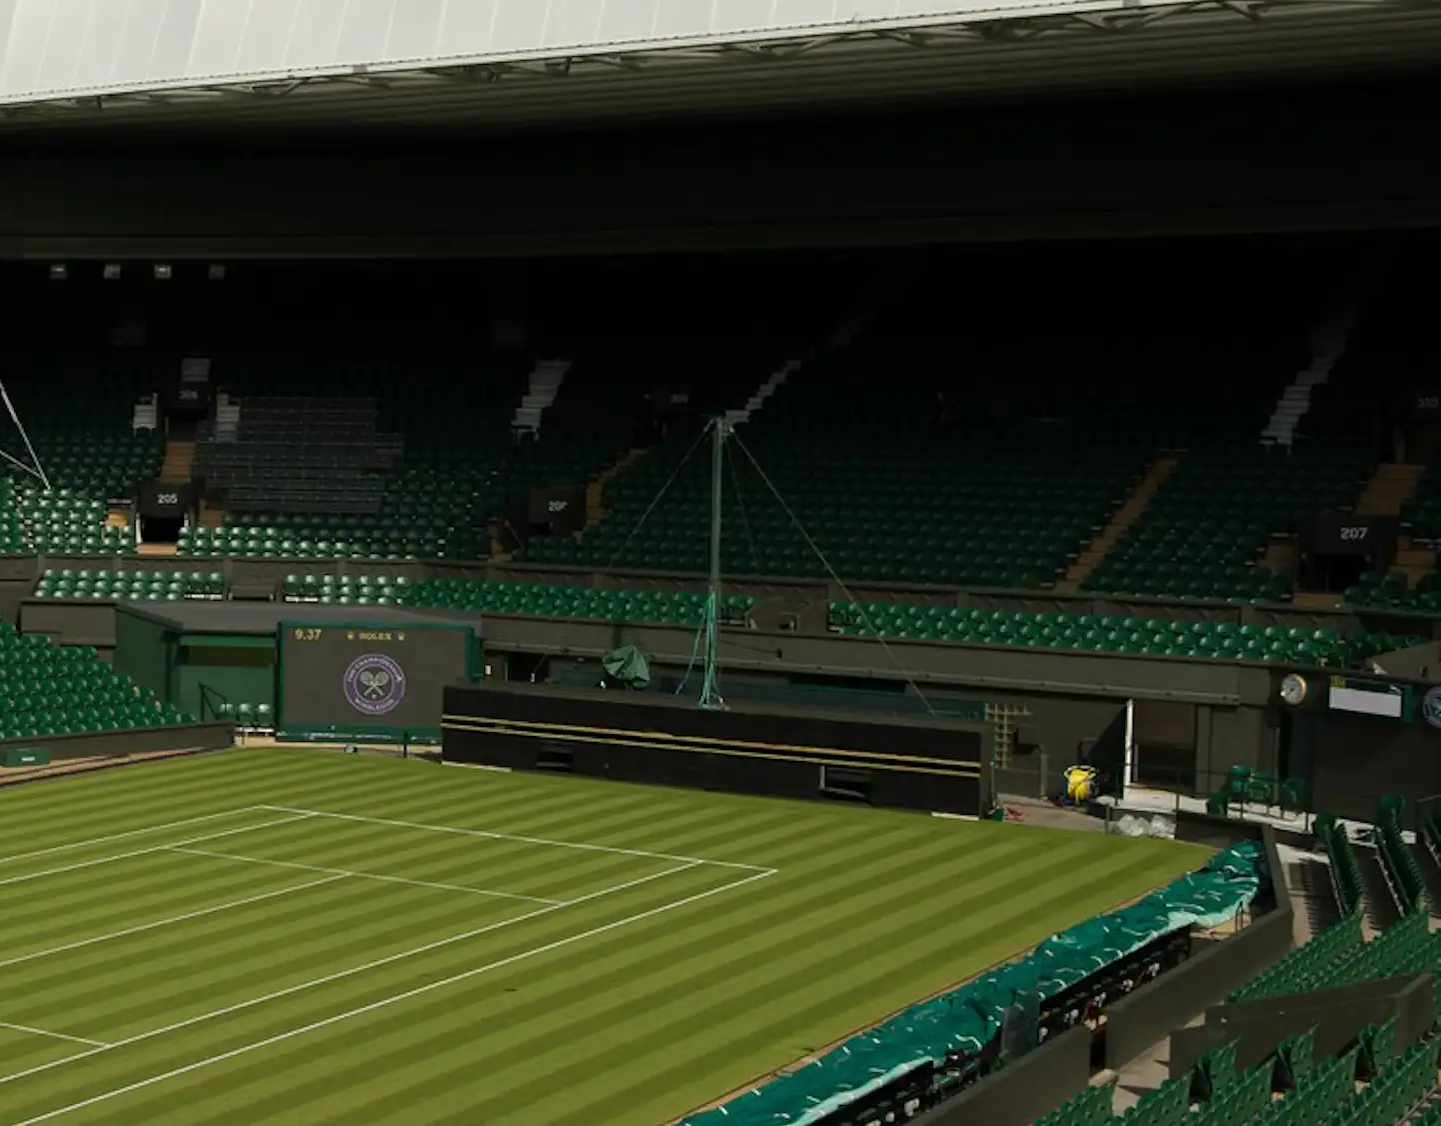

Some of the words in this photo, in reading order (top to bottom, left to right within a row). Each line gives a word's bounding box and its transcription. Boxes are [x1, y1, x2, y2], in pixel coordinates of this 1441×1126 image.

[157, 493, 178, 505] 205
[1340, 527, 1368, 541] 207
[294, 628, 323, 641] 9.37
